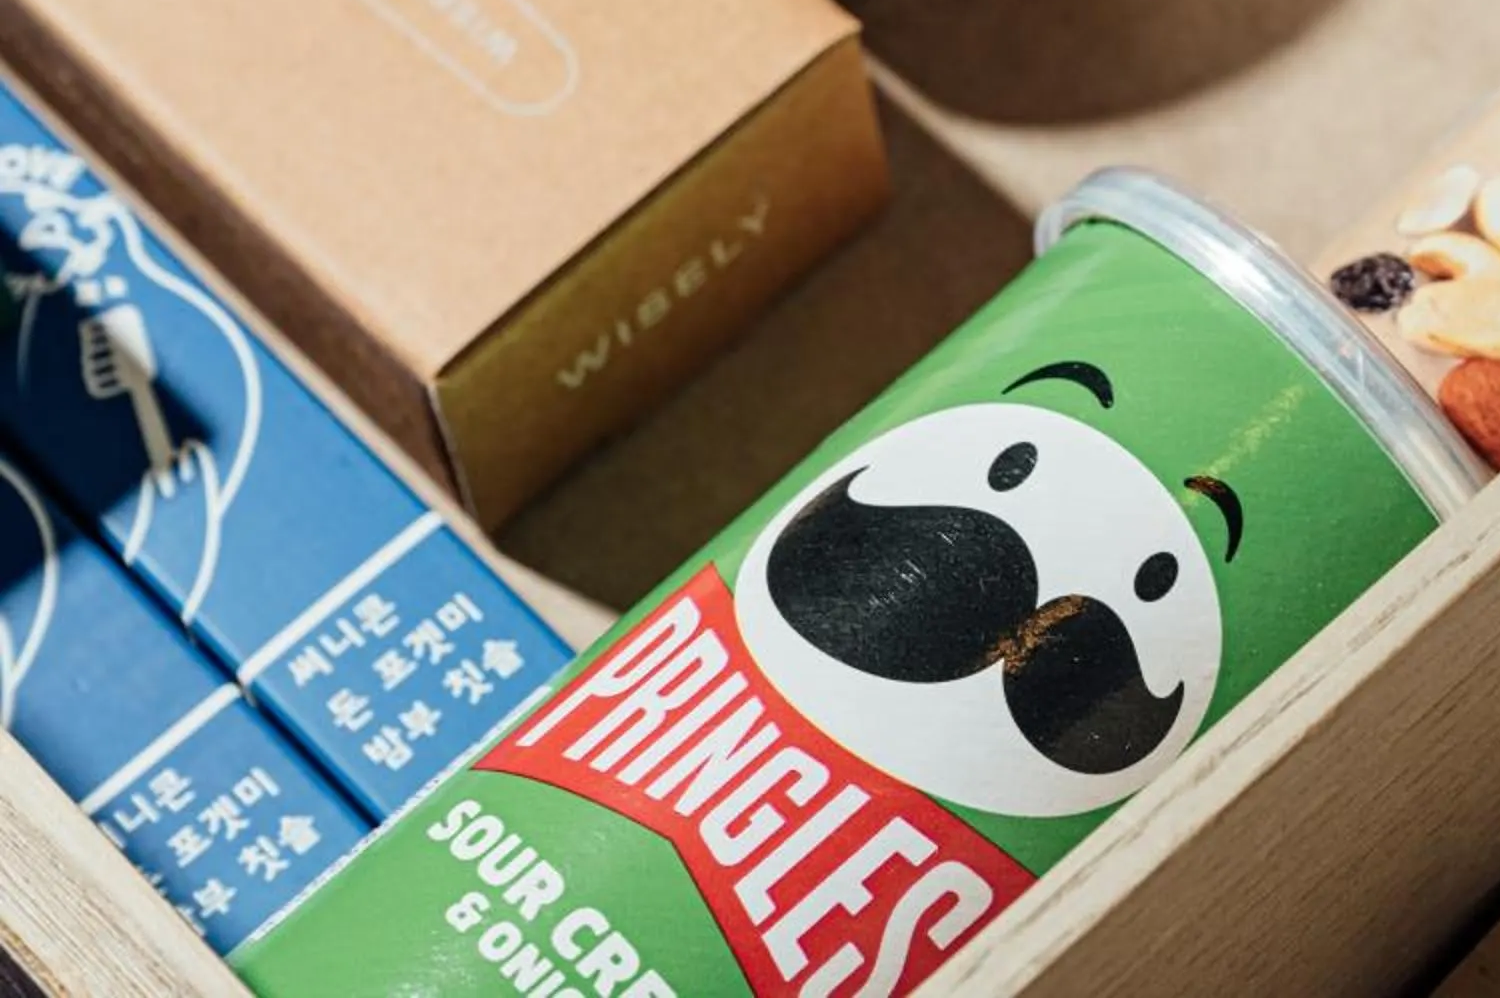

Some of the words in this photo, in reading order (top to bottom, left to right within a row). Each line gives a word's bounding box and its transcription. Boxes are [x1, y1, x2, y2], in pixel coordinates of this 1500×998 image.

[556, 195, 777, 395] WISELY
[442, 637, 525, 705] 칫솔
[237, 813, 322, 881] 칫솔
[514, 596, 994, 998] PRINGLES
[426, 799, 565, 922] SOUR
[444, 891, 491, 933] &
[478, 921, 586, 998] ONI
